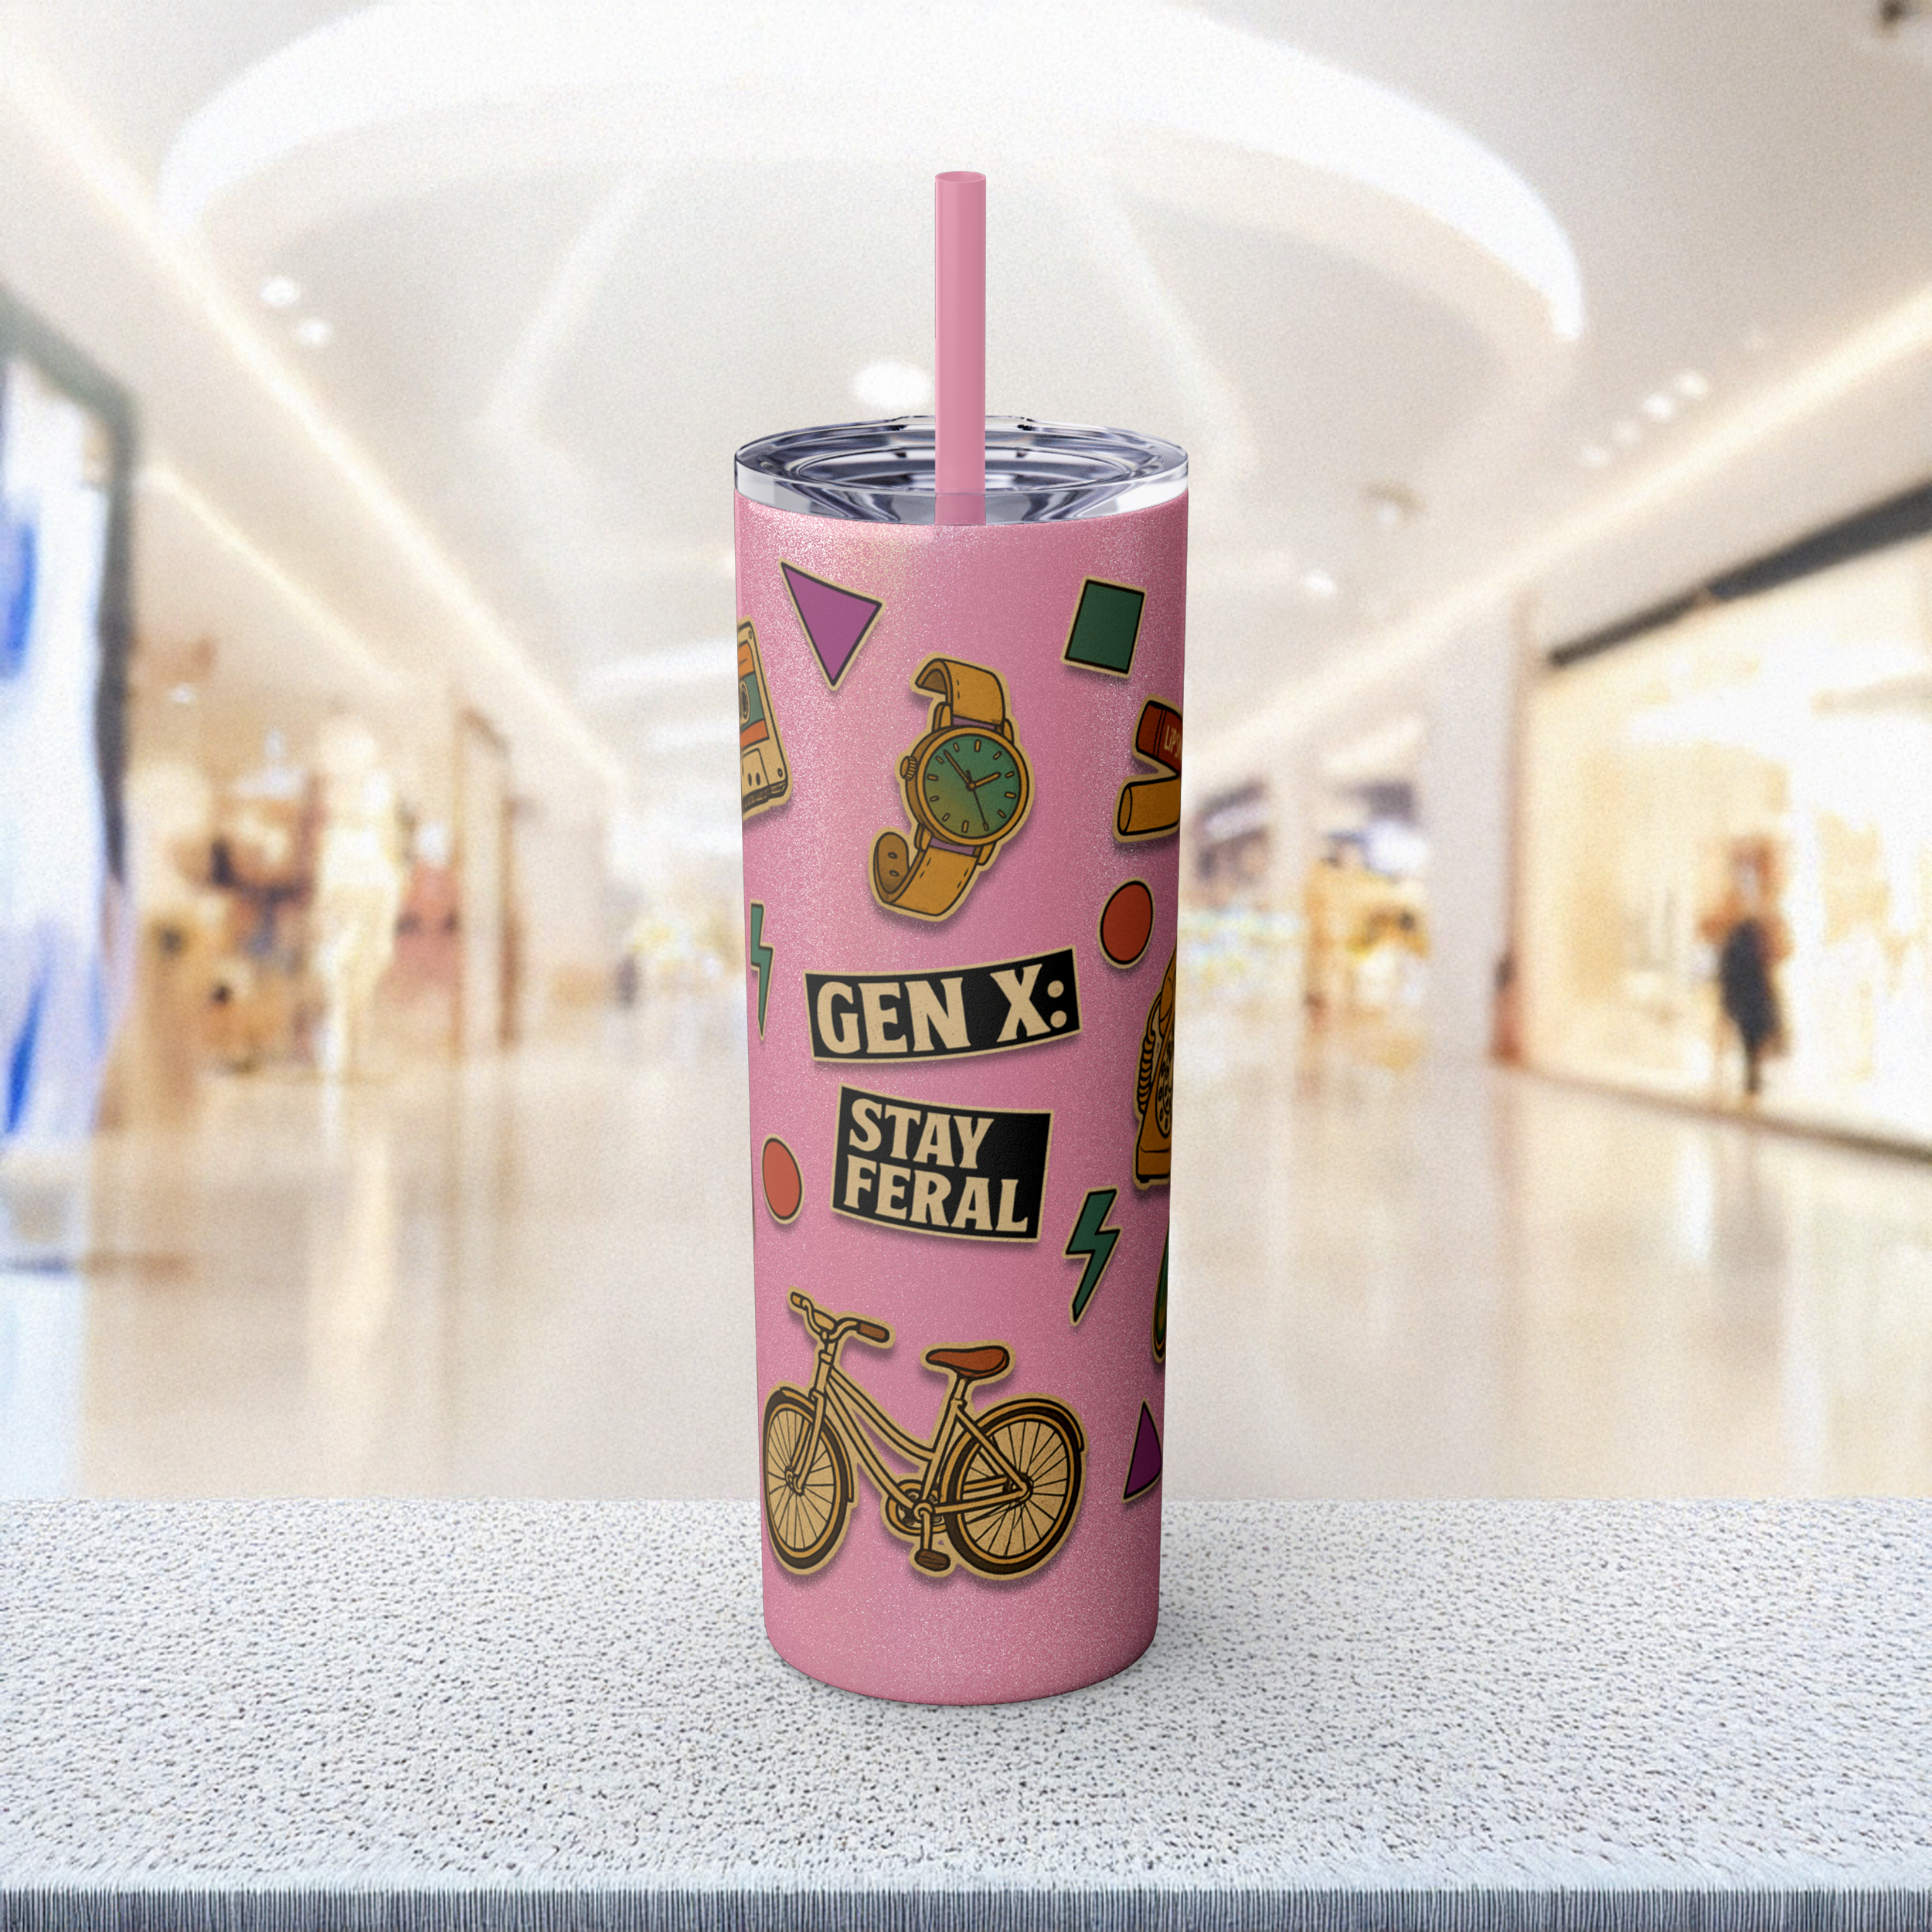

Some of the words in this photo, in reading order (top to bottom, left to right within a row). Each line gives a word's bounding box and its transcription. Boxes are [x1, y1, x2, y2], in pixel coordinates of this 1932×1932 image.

[817, 977, 971, 1054] GEN
[990, 964, 1067, 1043] X:
[849, 1098, 995, 1169] STAY
[844, 1154, 1029, 1233] FERAL
